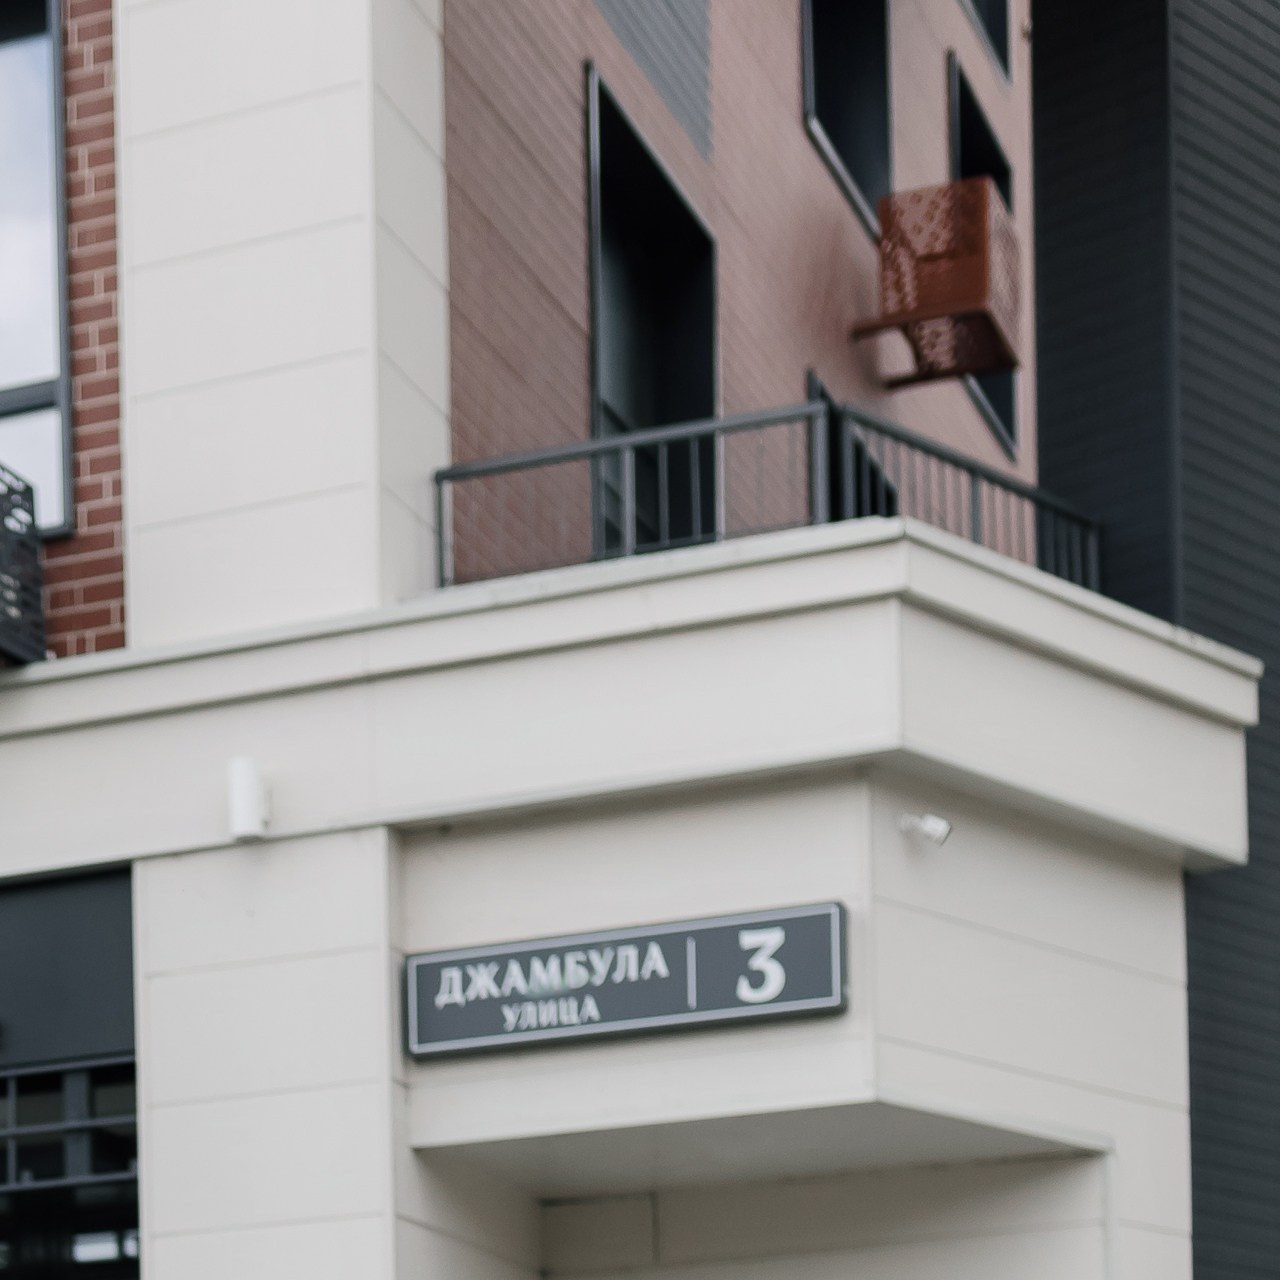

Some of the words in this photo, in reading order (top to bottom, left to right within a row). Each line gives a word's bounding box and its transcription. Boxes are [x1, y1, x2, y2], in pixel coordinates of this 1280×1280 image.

[434, 940, 670, 1010] ДЖАМБУЛА
[735, 926, 787, 1004] 3
[502, 995, 601, 1032] УЛИЦА
